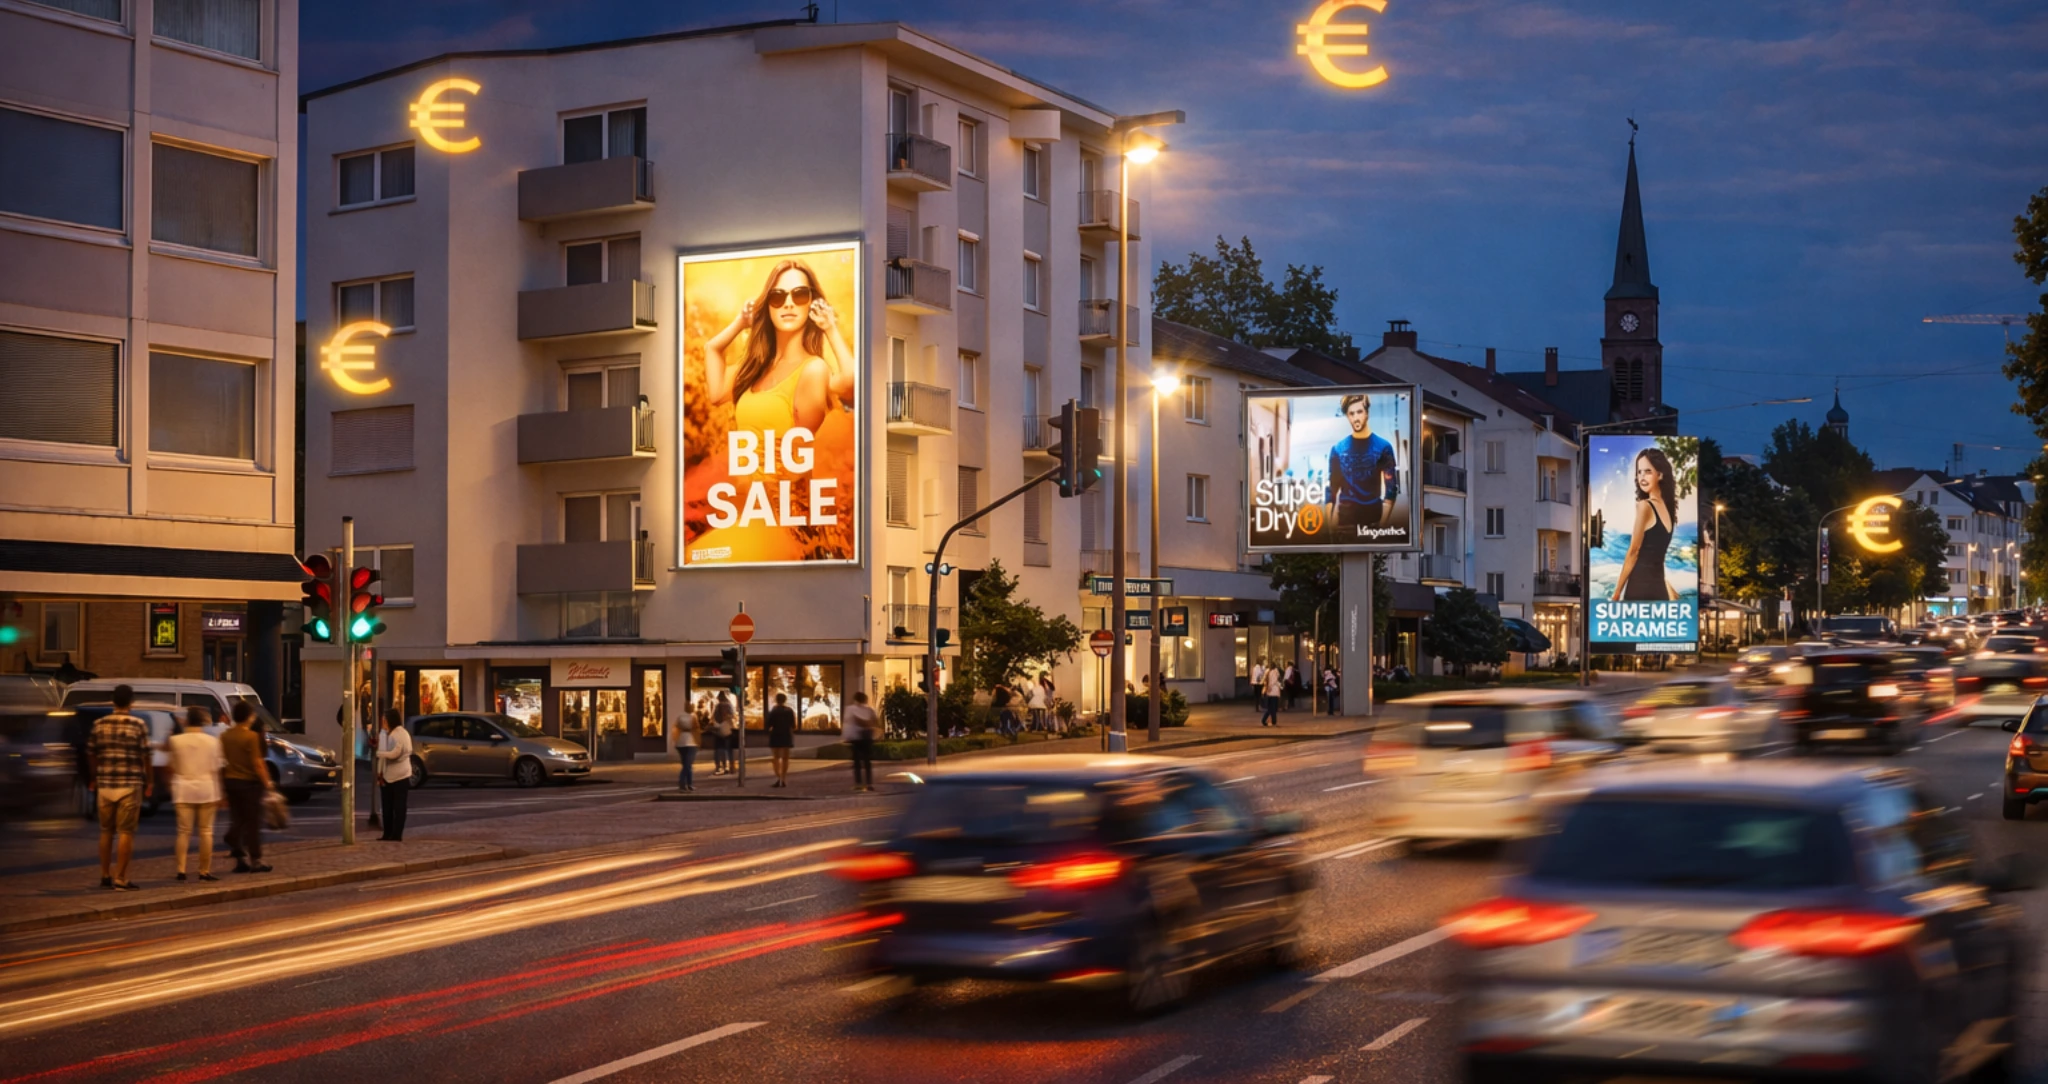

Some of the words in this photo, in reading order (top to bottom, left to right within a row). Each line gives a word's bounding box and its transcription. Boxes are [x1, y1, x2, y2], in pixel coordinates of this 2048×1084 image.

[728, 426, 815, 476] BIG
[705, 478, 838, 529] SALE
[1255, 479, 1330, 512] Super
[1595, 602, 1692, 620] SUMEMER
